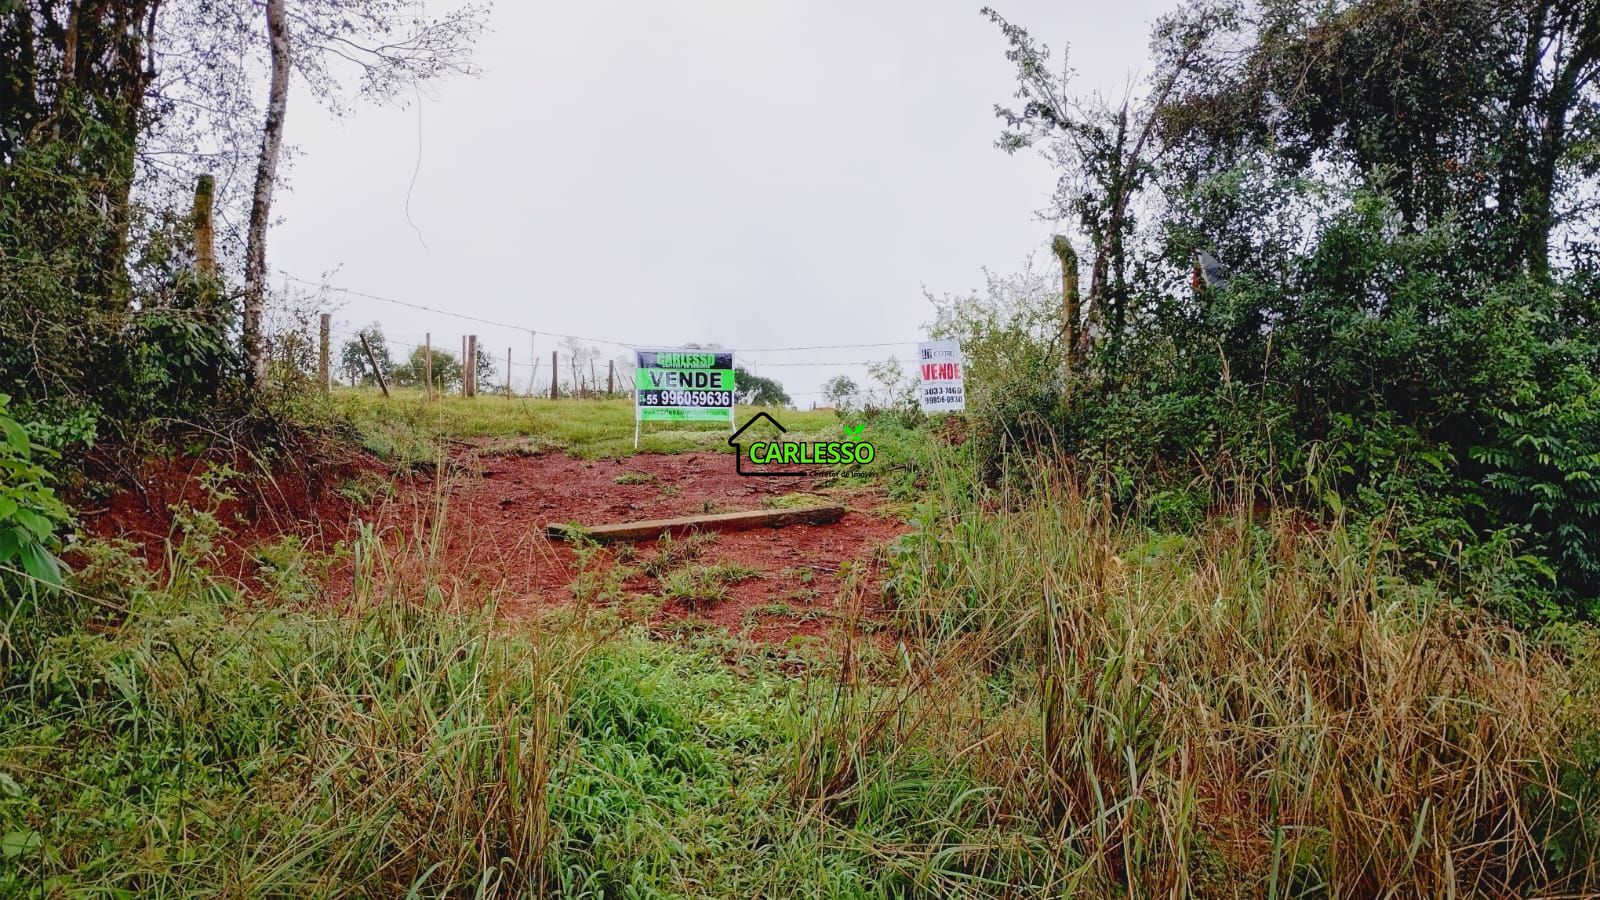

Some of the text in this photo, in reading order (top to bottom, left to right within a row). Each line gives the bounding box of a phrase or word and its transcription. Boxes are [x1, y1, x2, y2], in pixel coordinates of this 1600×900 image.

[656, 352, 714, 366] CARLESSO
[650, 371, 722, 388] VENDE
[922, 363, 960, 380] VENDE
[646, 390, 729, 405] 55 996059636
